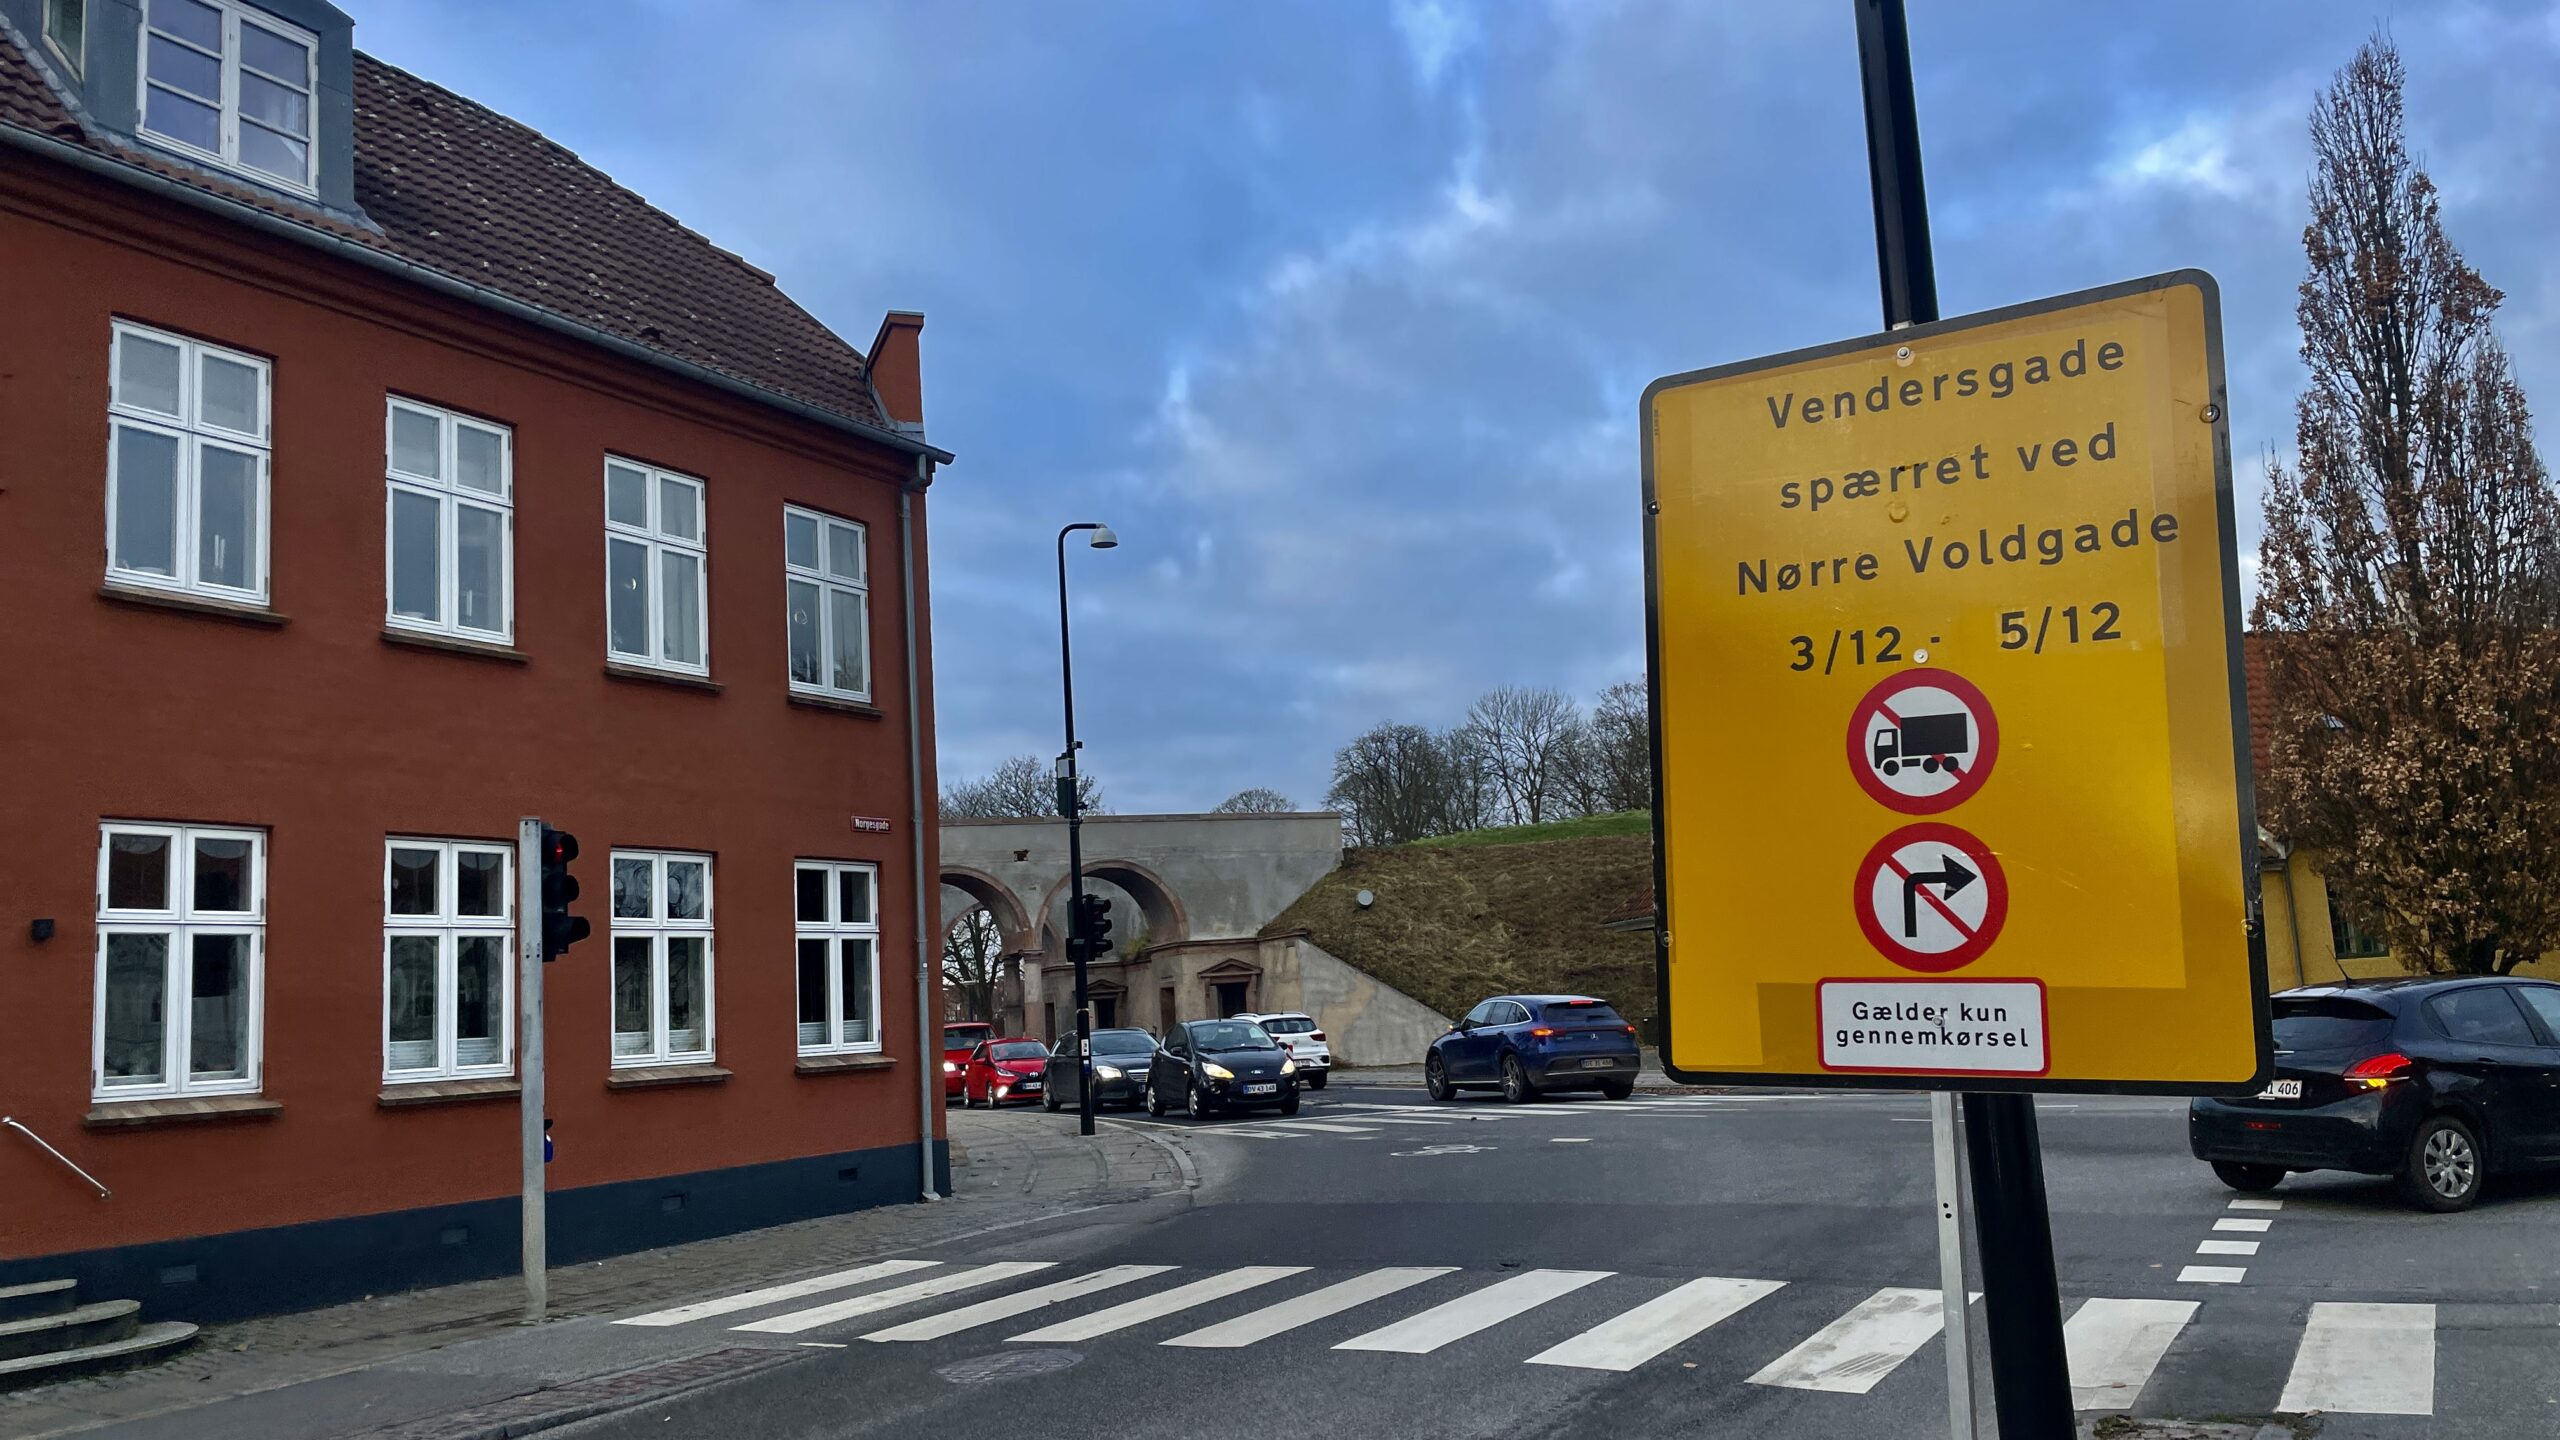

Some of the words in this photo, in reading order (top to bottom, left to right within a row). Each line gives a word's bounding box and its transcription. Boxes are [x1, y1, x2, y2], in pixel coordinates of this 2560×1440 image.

[1767, 338, 2125, 429] Vendersgade
[1781, 444, 1989, 511] spærret
[2017, 422, 2115, 471] ved
[1739, 554, 1878, 595] Nørre
[1904, 509, 2178, 573] Voldgade
[1790, 626, 1902, 675] 3/12
[2001, 602, 2121, 654] 5/12
[855, 818, 889, 831] Norgesgade
[1852, 1001, 1948, 1022] Gælder
[1961, 1003, 2006, 1021] kun
[1837, 1026, 2029, 1048] gennemkørsel
[2278, 1082, 2299, 1095] 406
